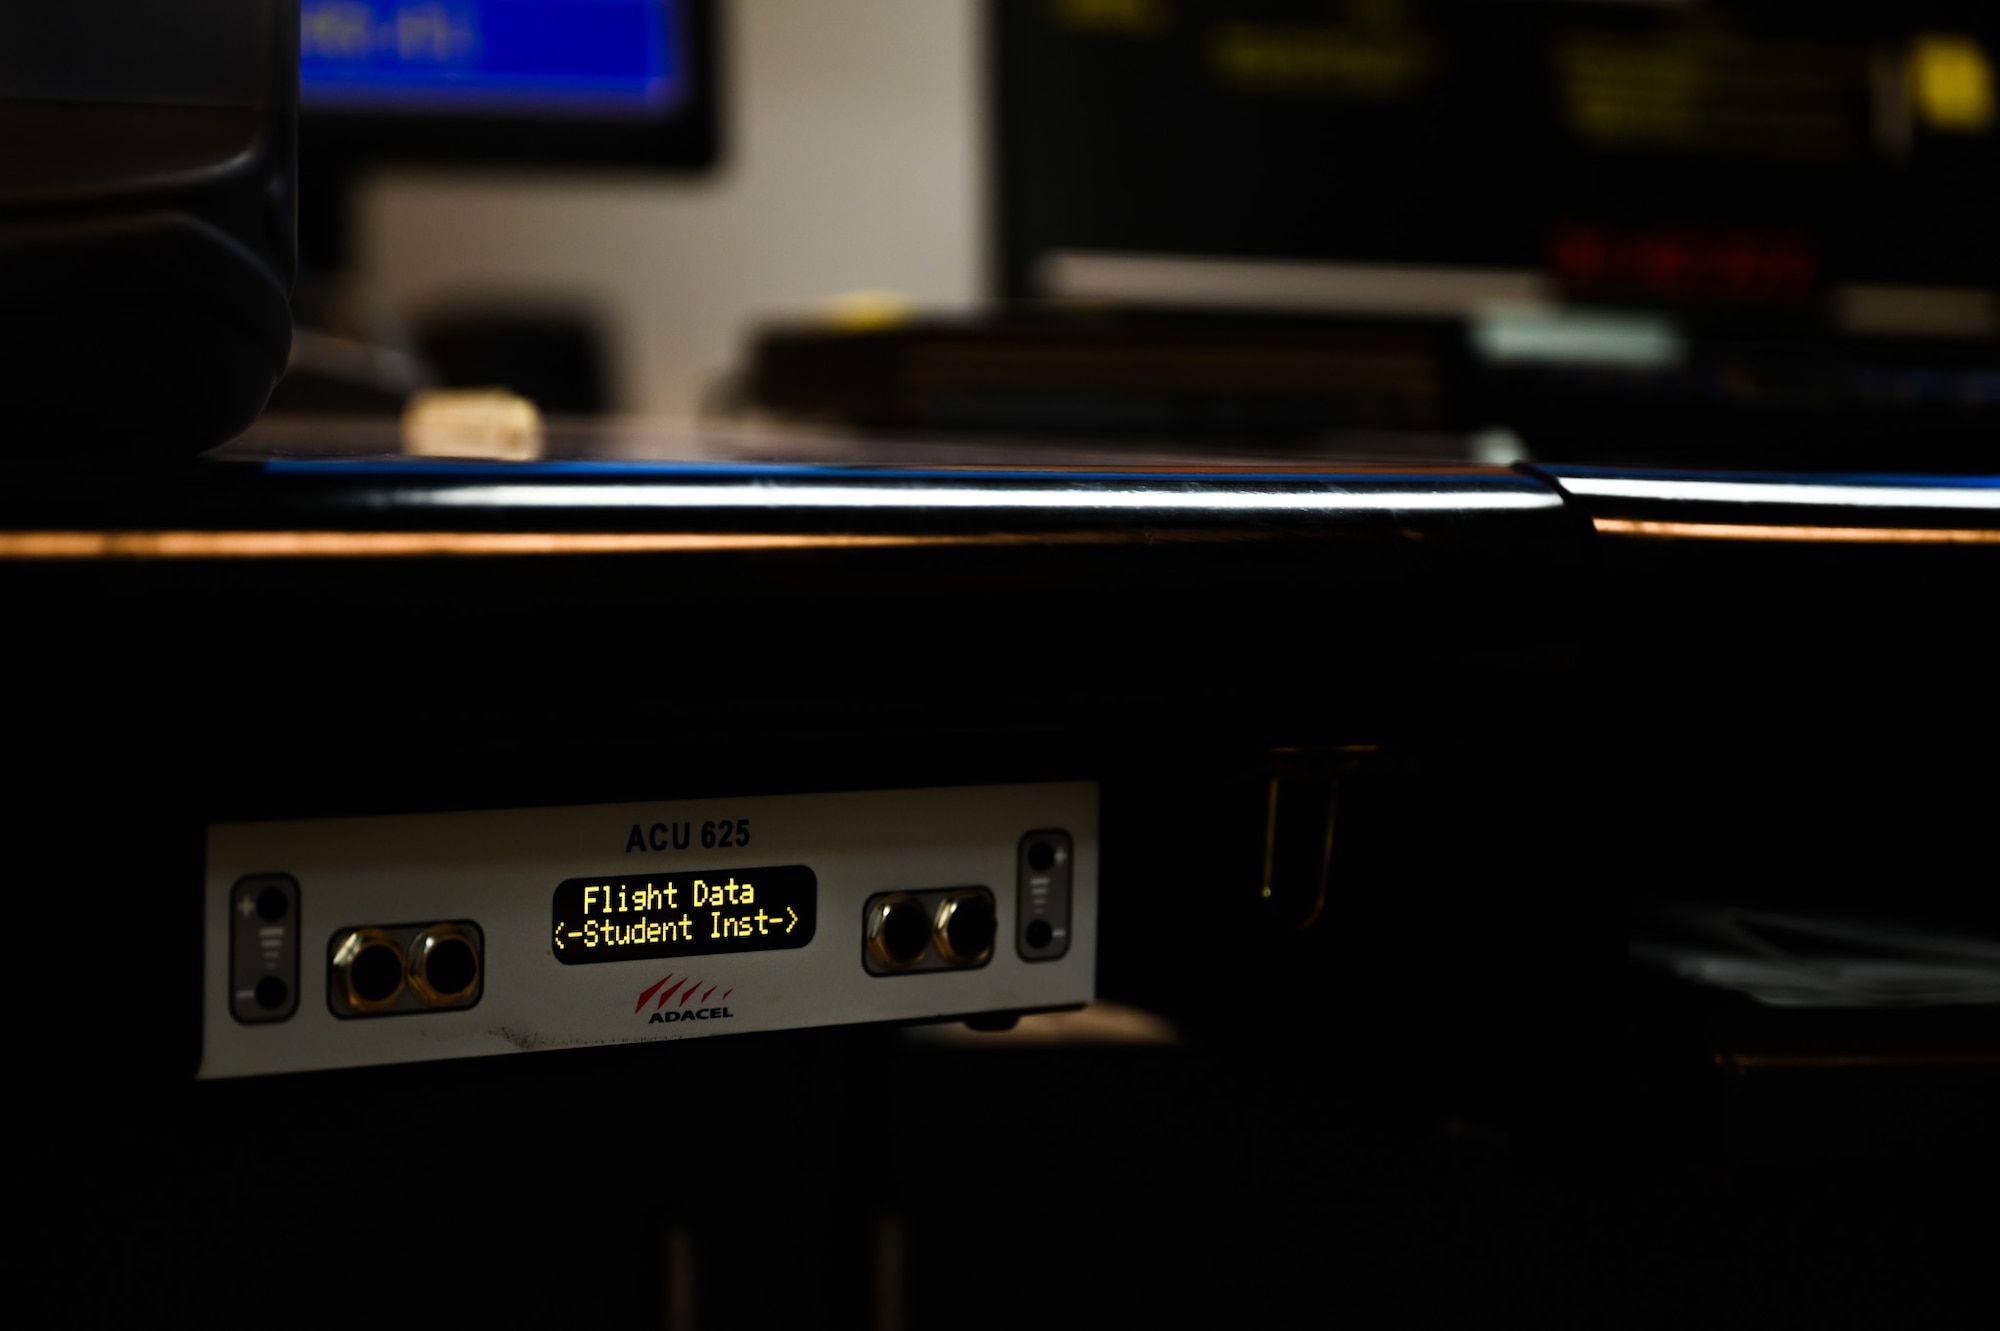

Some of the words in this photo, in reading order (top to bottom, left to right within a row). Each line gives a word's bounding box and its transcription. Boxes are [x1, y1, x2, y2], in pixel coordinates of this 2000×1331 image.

[625, 821, 691, 853] ACU
[701, 819, 751, 849] 625
[583, 881, 678, 915] Flight
[693, 877, 755, 908] Data
[648, 1007, 734, 1024] ADACEL
